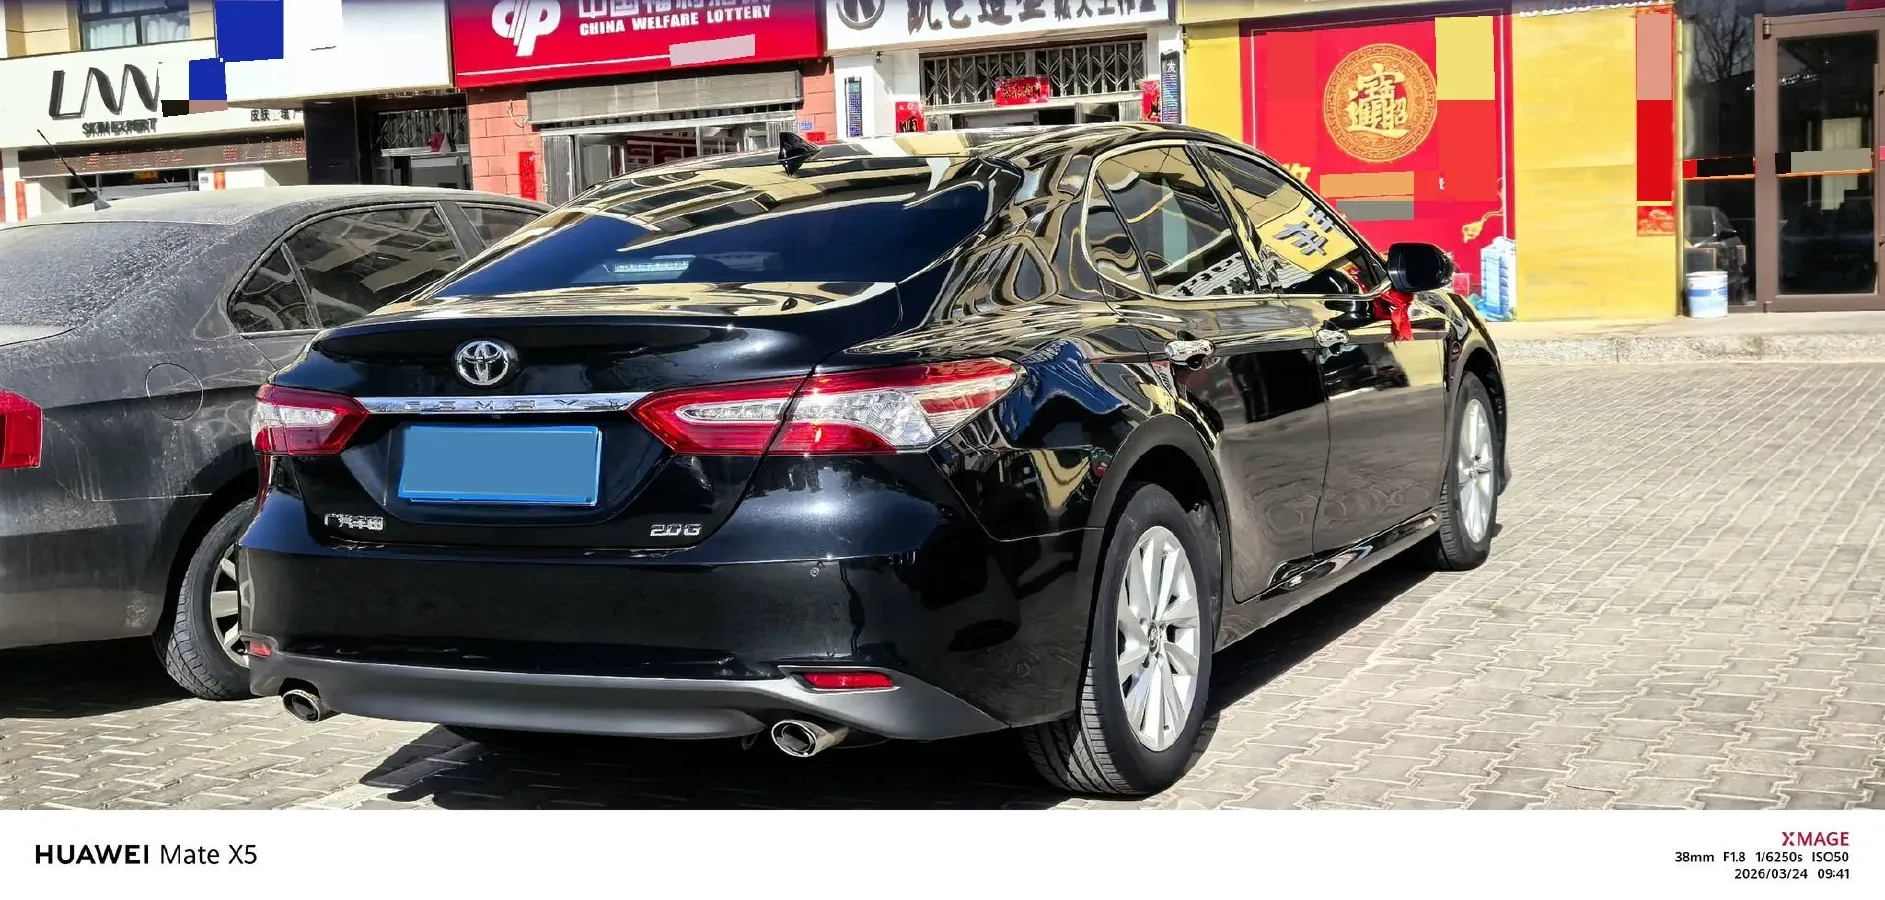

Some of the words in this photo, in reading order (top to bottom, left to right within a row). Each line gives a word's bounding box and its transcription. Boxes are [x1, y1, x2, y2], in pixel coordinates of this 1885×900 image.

[579, 20, 625, 36] CHINA
[632, 12, 699, 31] WELFARE
[707, 5, 771, 24] LOTTERY
